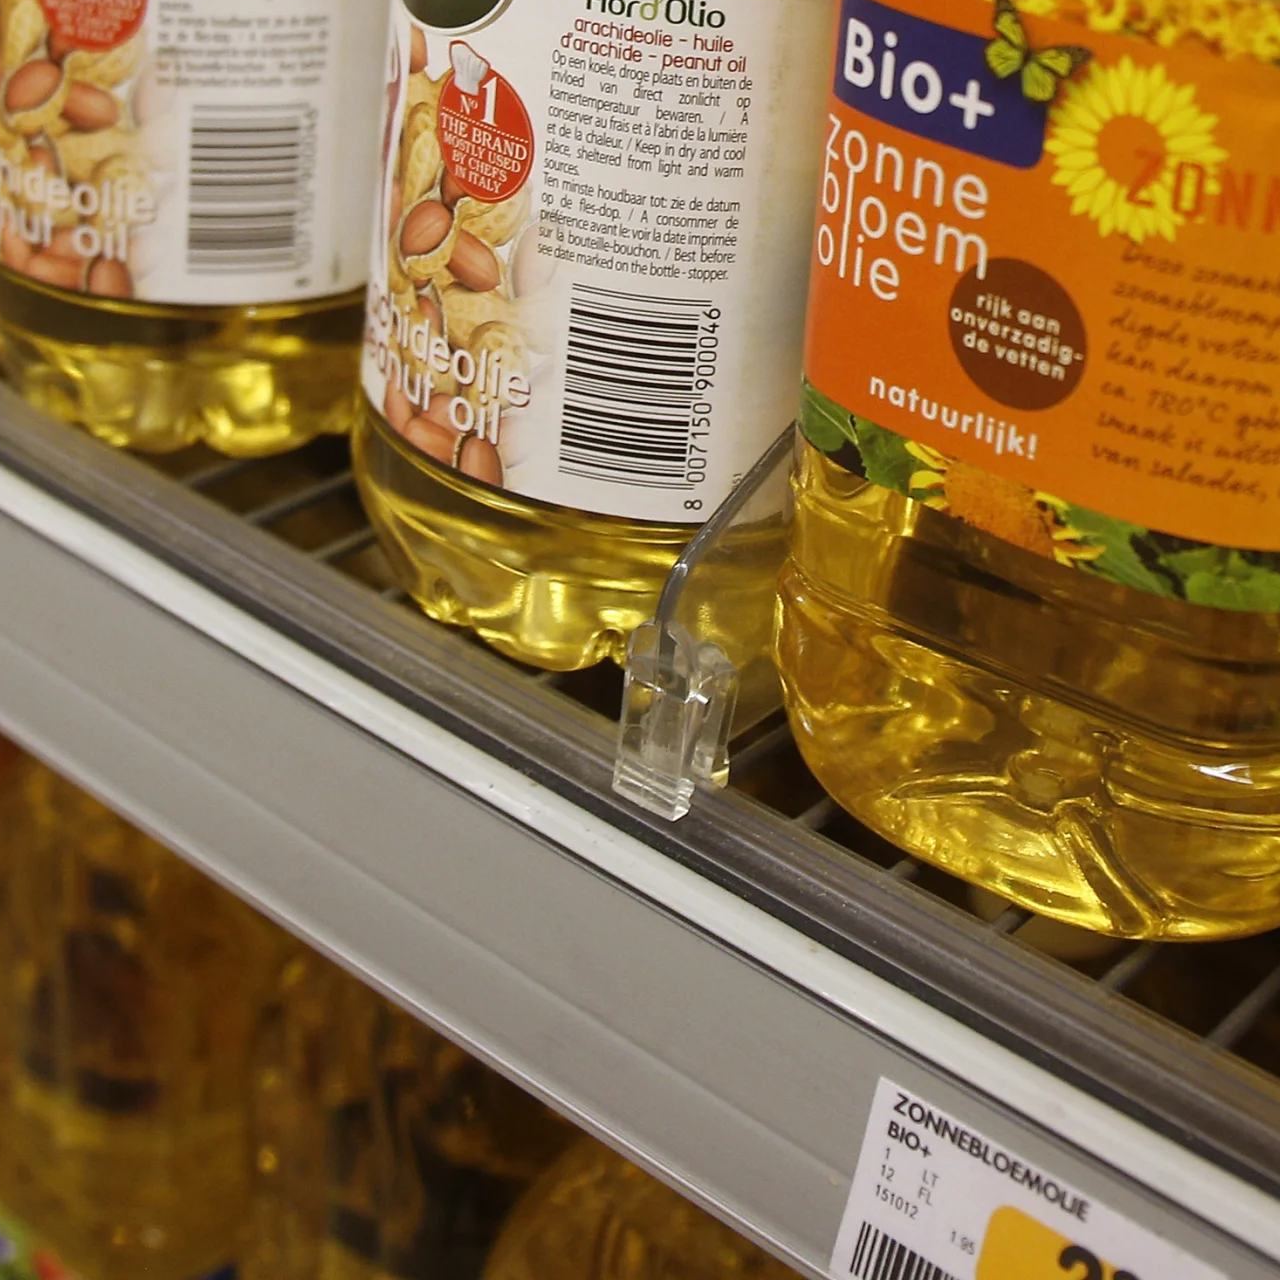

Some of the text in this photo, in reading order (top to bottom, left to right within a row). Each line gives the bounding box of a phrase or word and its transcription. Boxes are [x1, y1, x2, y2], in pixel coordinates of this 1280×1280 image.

[561, 32, 747, 73] d'arachide peanut oil
[574, 18, 734, 53] arachideolie huile
[551, 66, 751, 111] invloed van direct zonlicht op
[552, 49, 753, 91] Op een koele, droge plaats en buiten de
[843, 17, 995, 130] Bio+
[482, 76, 497, 126] 1
[549, 84, 749, 125] kamertemperatuur bewaren. A
[440, 112, 527, 161] THE BRAND
[547, 122, 746, 162] et de la chaleur. Keep in dry and cool
[548, 104, 747, 143] conserver au frais et à l'abri de la lumière
[444, 131, 521, 173] MOSTLY USED
[451, 149, 508, 183] BY CHEFS
[543, 157, 580, 176] sources.
[545, 139, 744, 178] place, sheltered from light and warm
[826, 114, 988, 219] zonne
[455, 164, 503, 194] IN ITALY
[543, 172, 741, 212] Ten minste houdbaar tot: zie de datum
[540, 208, 737, 250] préférence avant le: voir la date imprimée
[541, 191, 739, 230] op de fles-dop. A consommer de
[822, 150, 988, 280] bloem
[73, 220, 128, 261] oil
[538, 224, 736, 264] sur la bouteille-bouchon. Best before:
[818, 220, 900, 300] olie
[536, 242, 729, 284] see date marked on the bottle stopper.
[976, 293, 1061, 335] rijk aan
[950, 306, 1085, 366] onverzadig-
[963, 331, 1065, 381] de vetten
[448, 395, 502, 446] oil
[683, 307, 722, 511] 8 007150 900046
[870, 375, 1038, 461] natuurlijk!
[886, 1120, 933, 1158] BIO+
[893, 1091, 1091, 1222] ZONNEBLOEMOLIE
[880, 1164, 934, 1207] 12 FL
[885, 1147, 939, 1188] 1 LT
[875, 1184, 918, 1220] 151012
